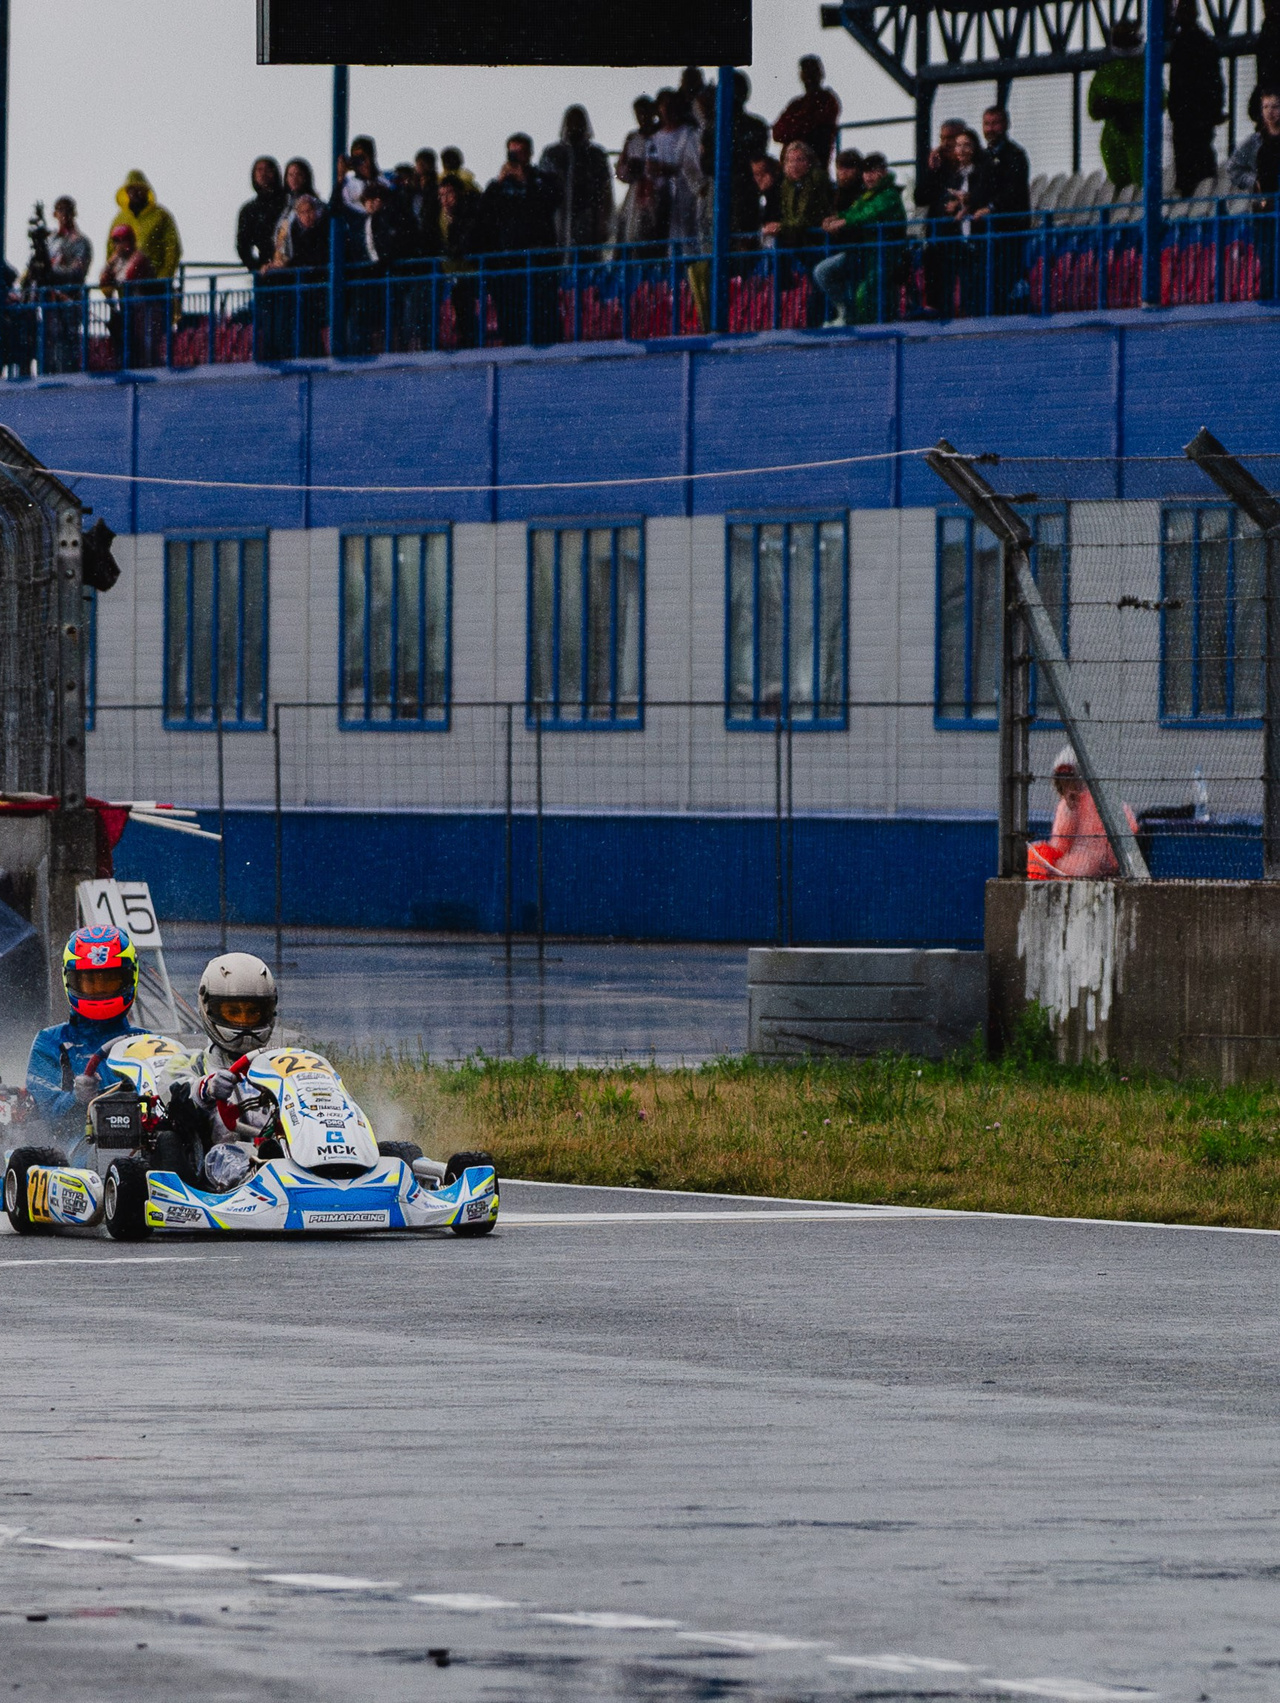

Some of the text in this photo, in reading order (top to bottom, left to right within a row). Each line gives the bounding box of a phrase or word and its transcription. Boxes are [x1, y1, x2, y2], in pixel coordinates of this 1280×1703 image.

[97, 892, 155, 935] 15
[147, 1040, 174, 1056] 2
[278, 1056, 331, 1074] 22
[109, 1115, 131, 1124] DRG
[317, 1145, 358, 1157] MCK
[31, 1169, 50, 1217] 22
[309, 1213, 386, 1223] PRIMARACING
